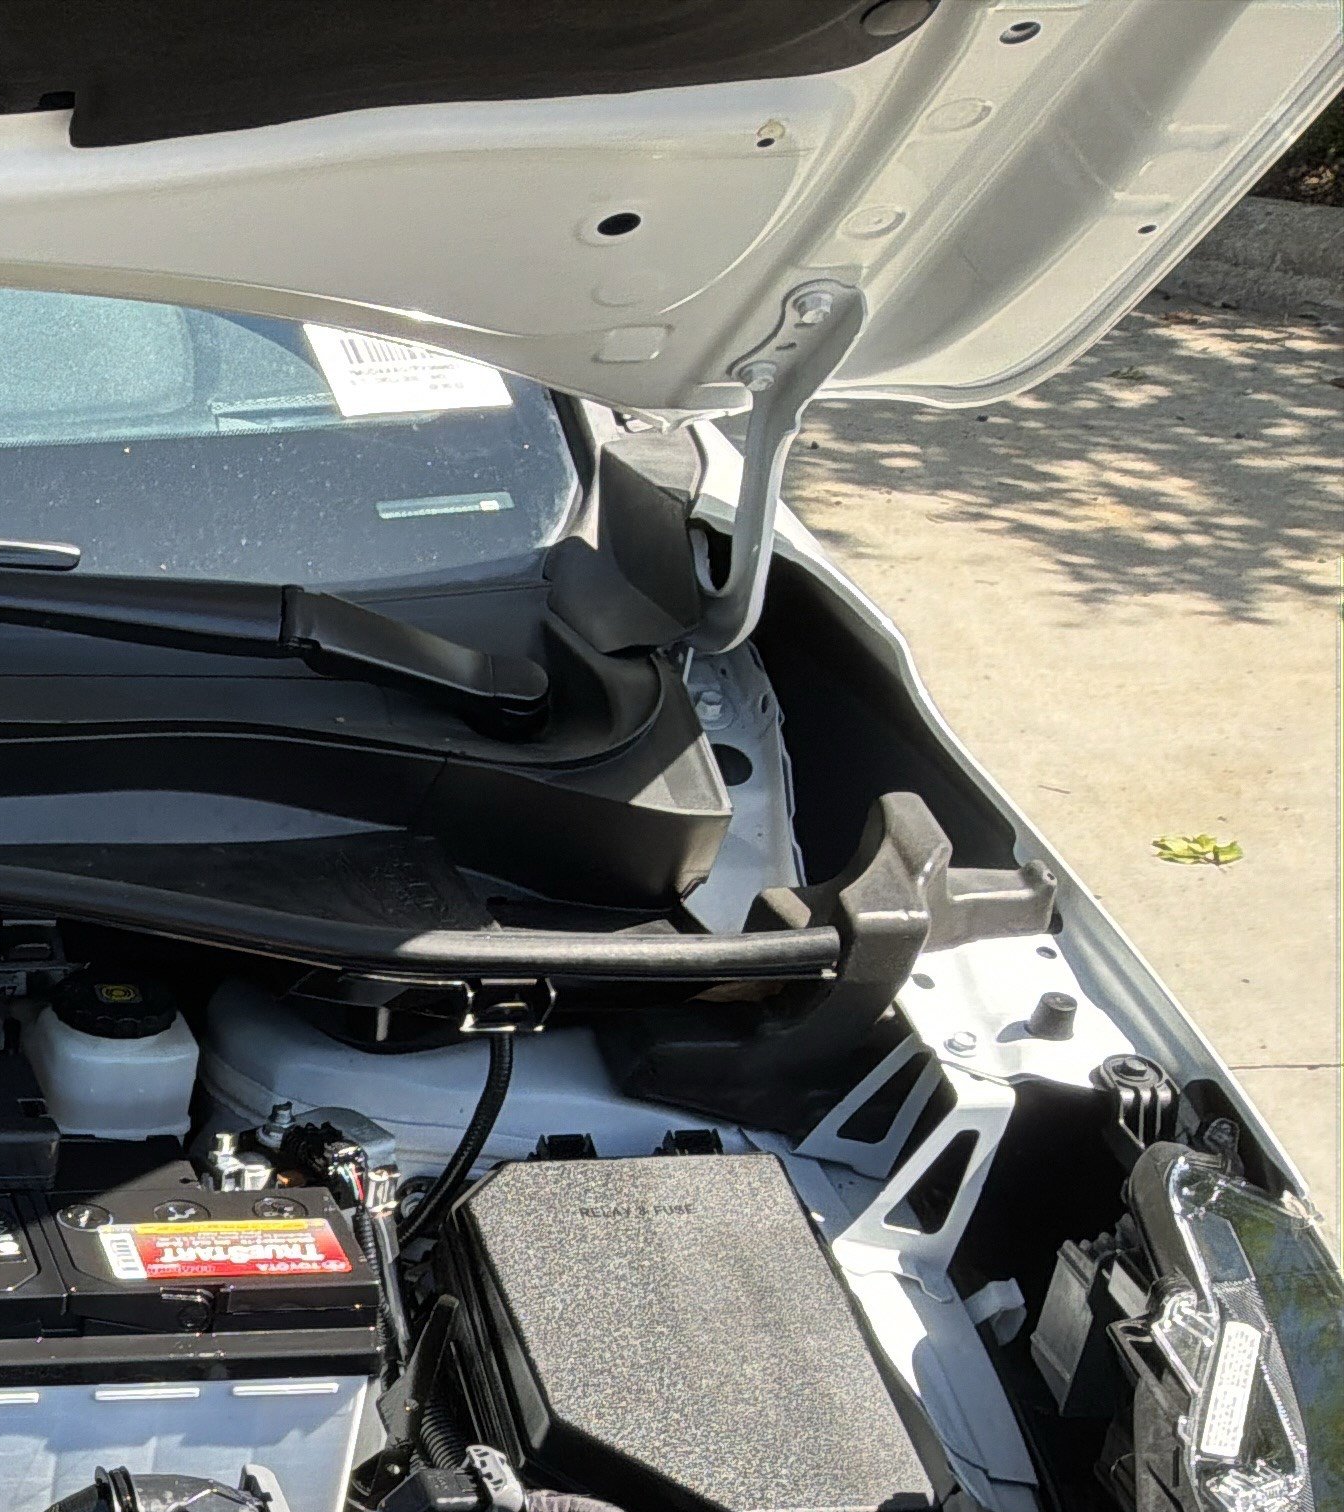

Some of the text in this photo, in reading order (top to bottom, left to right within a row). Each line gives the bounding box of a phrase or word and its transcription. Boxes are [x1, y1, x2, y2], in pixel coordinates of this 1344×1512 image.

[579, 1206, 631, 1218] RELAY
[653, 1203, 698, 1216] FUSE
[256, 1262, 321, 1272] TOYOTA
